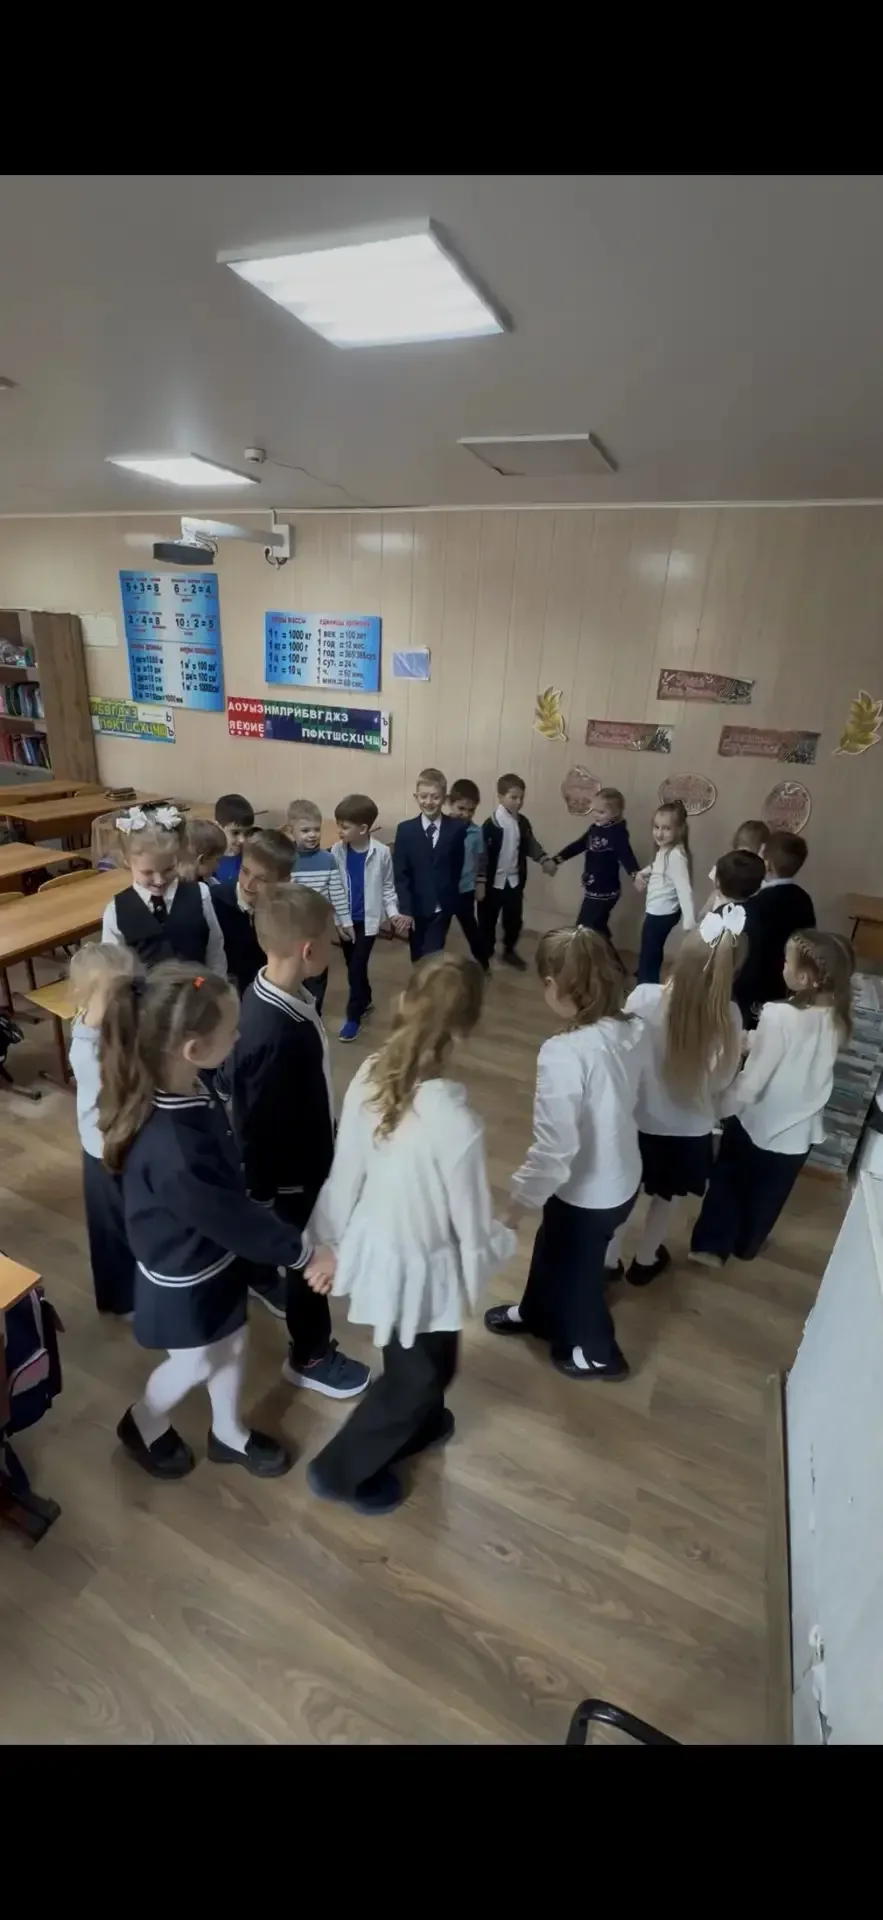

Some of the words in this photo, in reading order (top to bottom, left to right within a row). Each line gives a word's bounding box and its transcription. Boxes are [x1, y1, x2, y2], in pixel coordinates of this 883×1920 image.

[174, 584, 180, 593] 6
[191, 584, 197, 594] 2
[205, 585, 211, 594] 4
[175, 618, 185, 627] 10
[289, 629, 304, 640] 1000
[323, 630, 336, 638] век
[289, 641, 304, 652] 1000
[323, 640, 336, 649] год
[289, 653, 300, 664] 100
[323, 650, 336, 658] год
